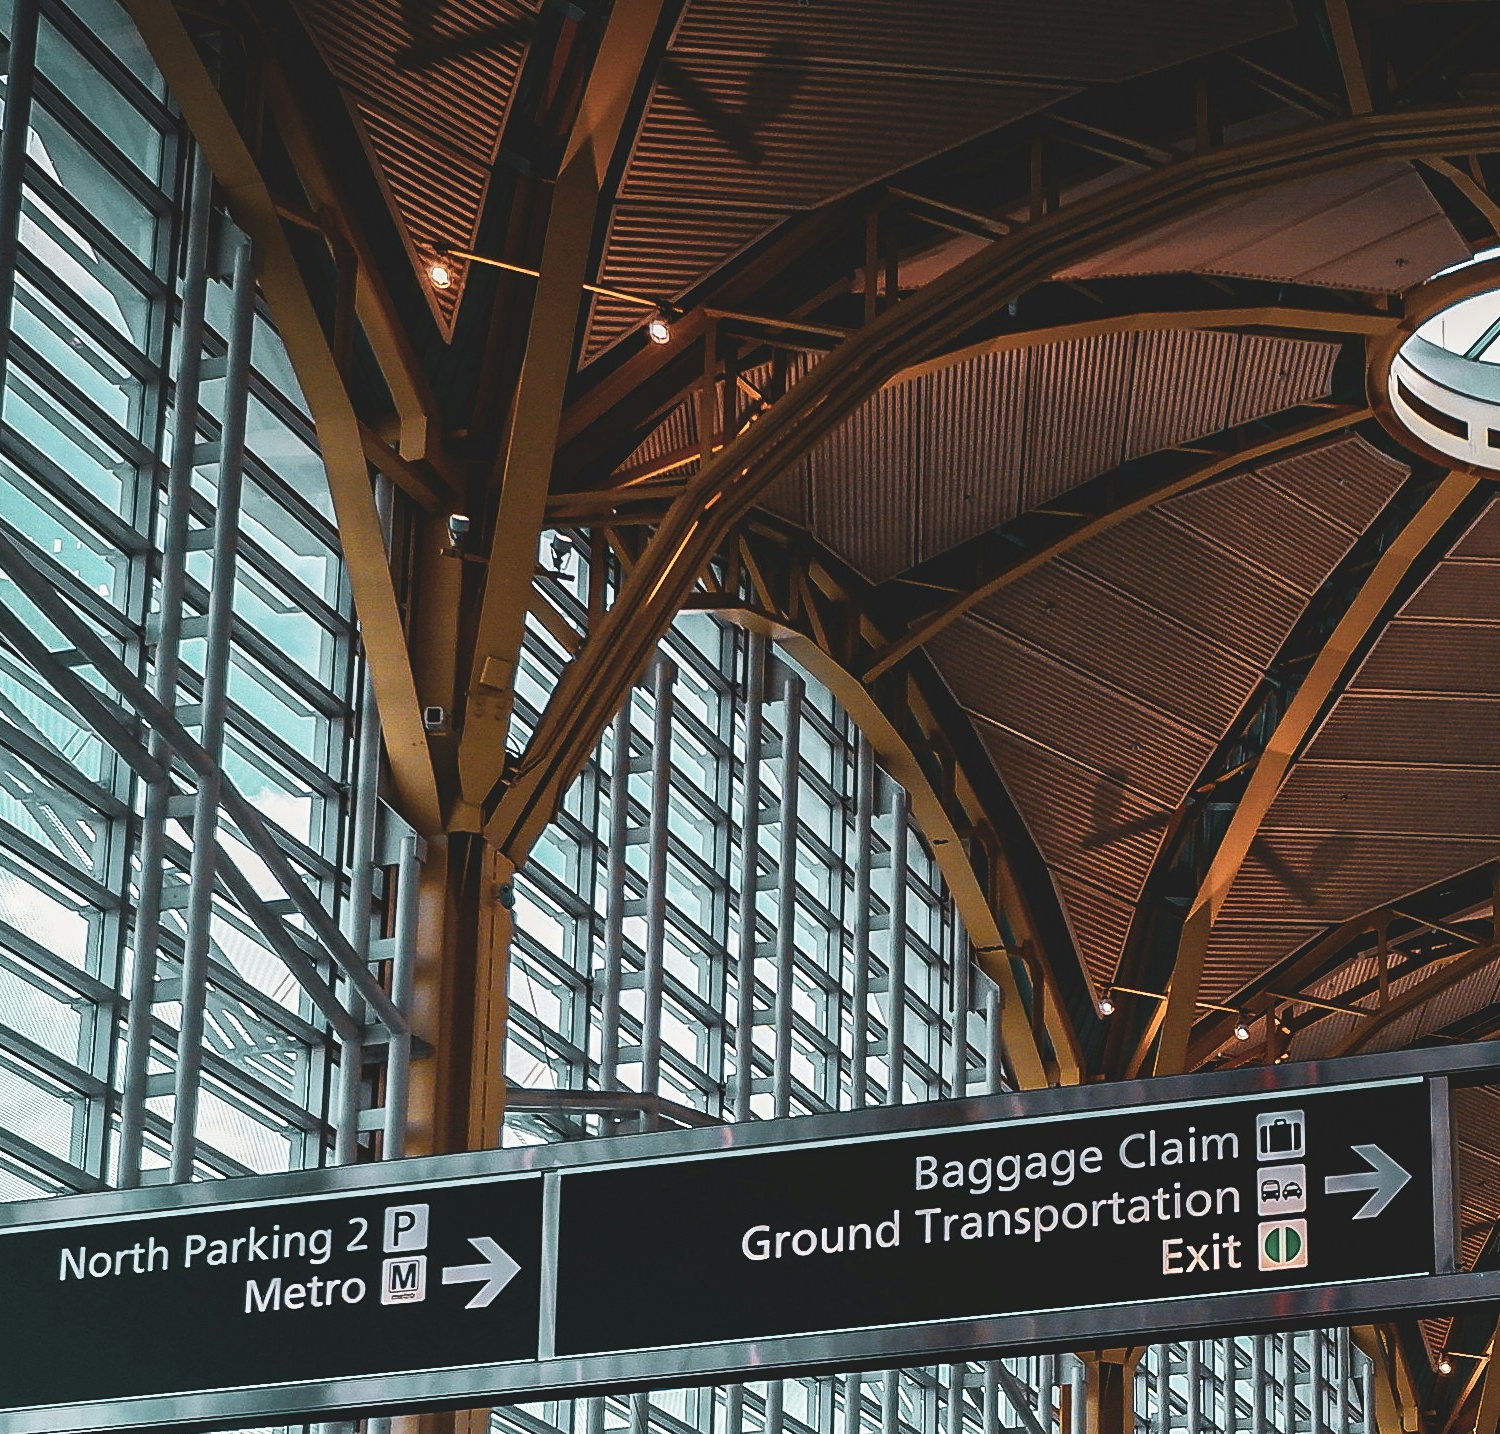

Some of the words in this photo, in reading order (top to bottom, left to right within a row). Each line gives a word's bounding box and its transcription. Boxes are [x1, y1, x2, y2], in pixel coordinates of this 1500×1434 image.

[915, 1142, 1103, 1195] Baggage
[1119, 1125, 1239, 1170] Claim
[59, 1237, 169, 1281] North
[184, 1225, 333, 1269] Parking
[347, 1217, 369, 1252] 2
[393, 1211, 416, 1246] P
[741, 1210, 901, 1262] Ground
[915, 1181, 1241, 1246] Transportation
[1162, 1232, 1242, 1276] Exit
[244, 1276, 366, 1314] Metro
